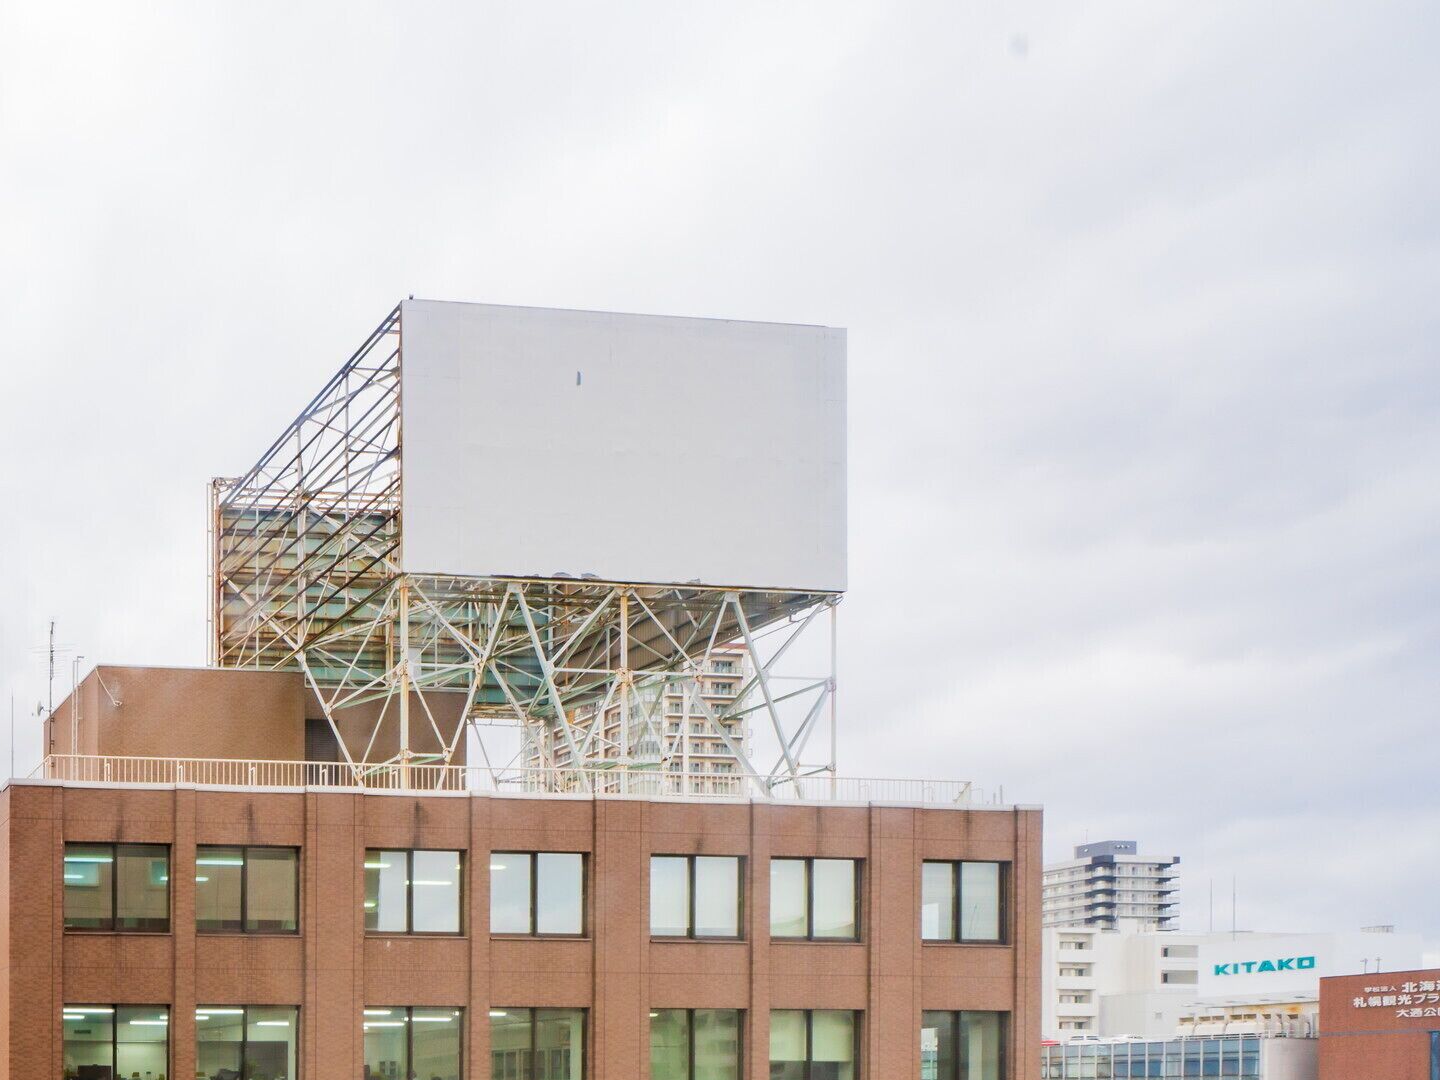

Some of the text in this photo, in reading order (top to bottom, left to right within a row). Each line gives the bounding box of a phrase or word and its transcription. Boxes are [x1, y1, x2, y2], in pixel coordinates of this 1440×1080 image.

[1214, 956, 1315, 976] KITAKO
[1401, 980, 1440, 993] 北海
[1396, 1007, 1440, 1018] 大通公
